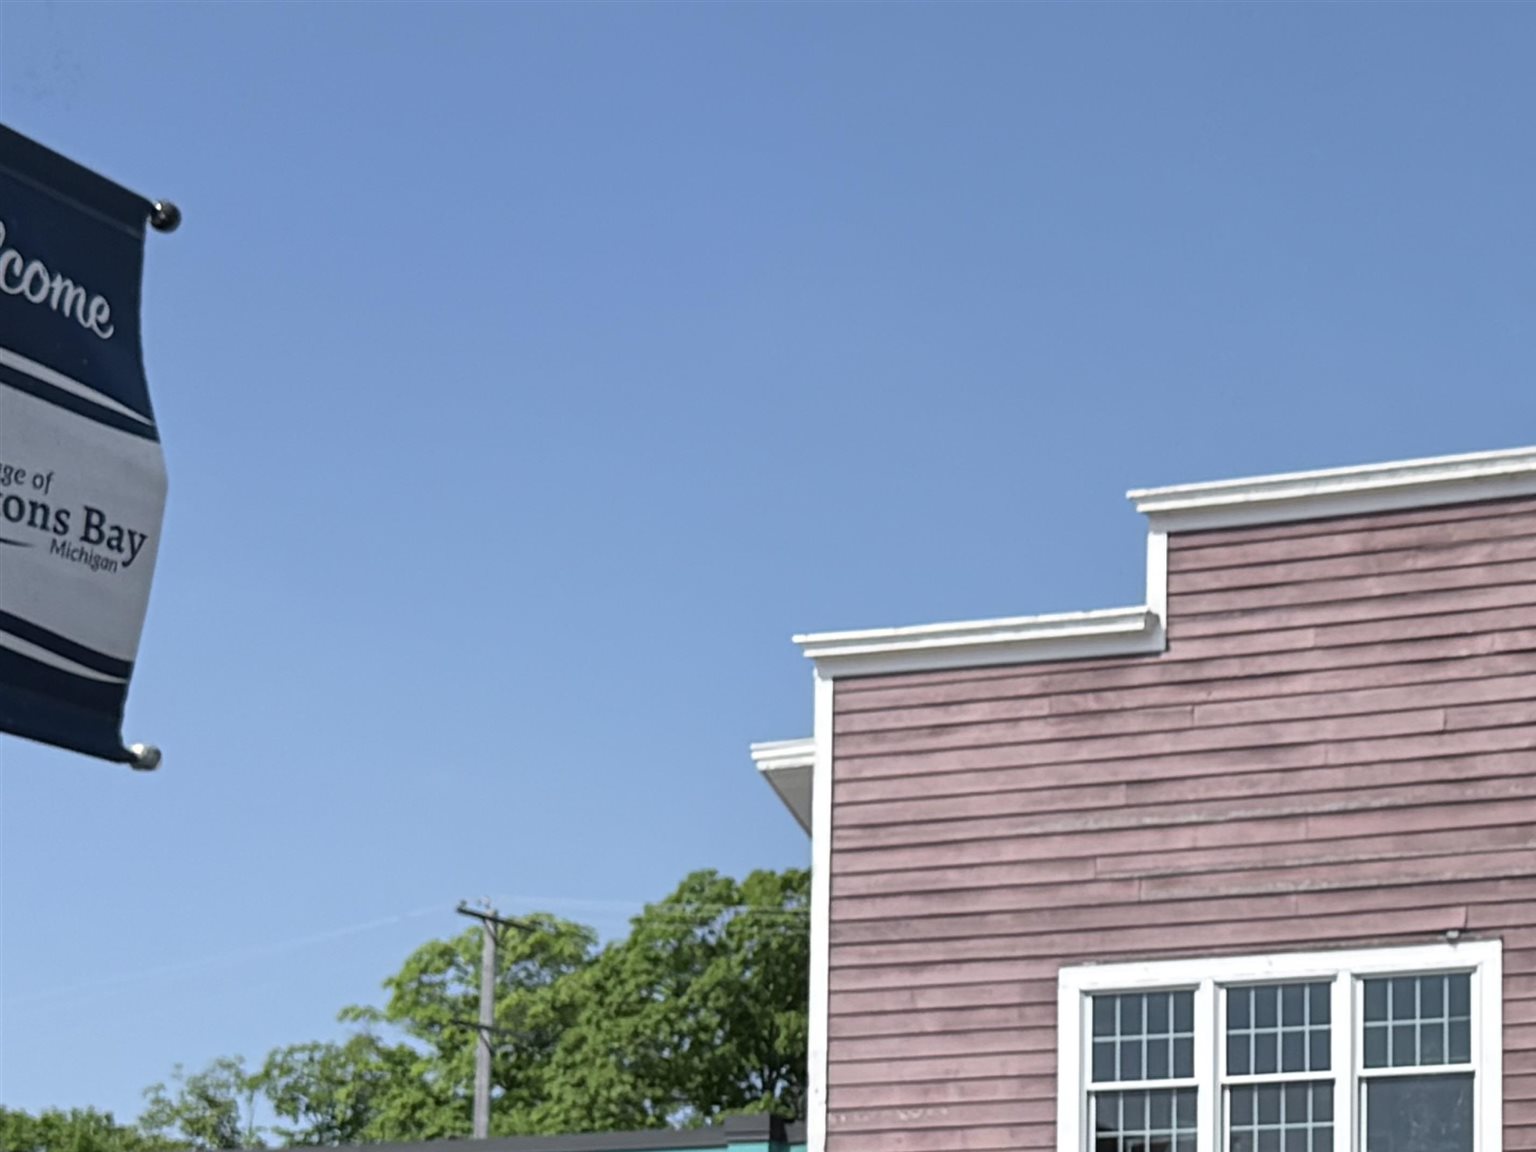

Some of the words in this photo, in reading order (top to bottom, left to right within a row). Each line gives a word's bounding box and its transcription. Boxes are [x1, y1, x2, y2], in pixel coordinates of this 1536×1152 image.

[0, 222, 114, 339] come
[0, 463, 26, 487] ge
[32, 471, 55, 495] of
[0, 493, 71, 536] ons
[79, 505, 148, 568] Bay
[50, 538, 118, 573] Michigan
